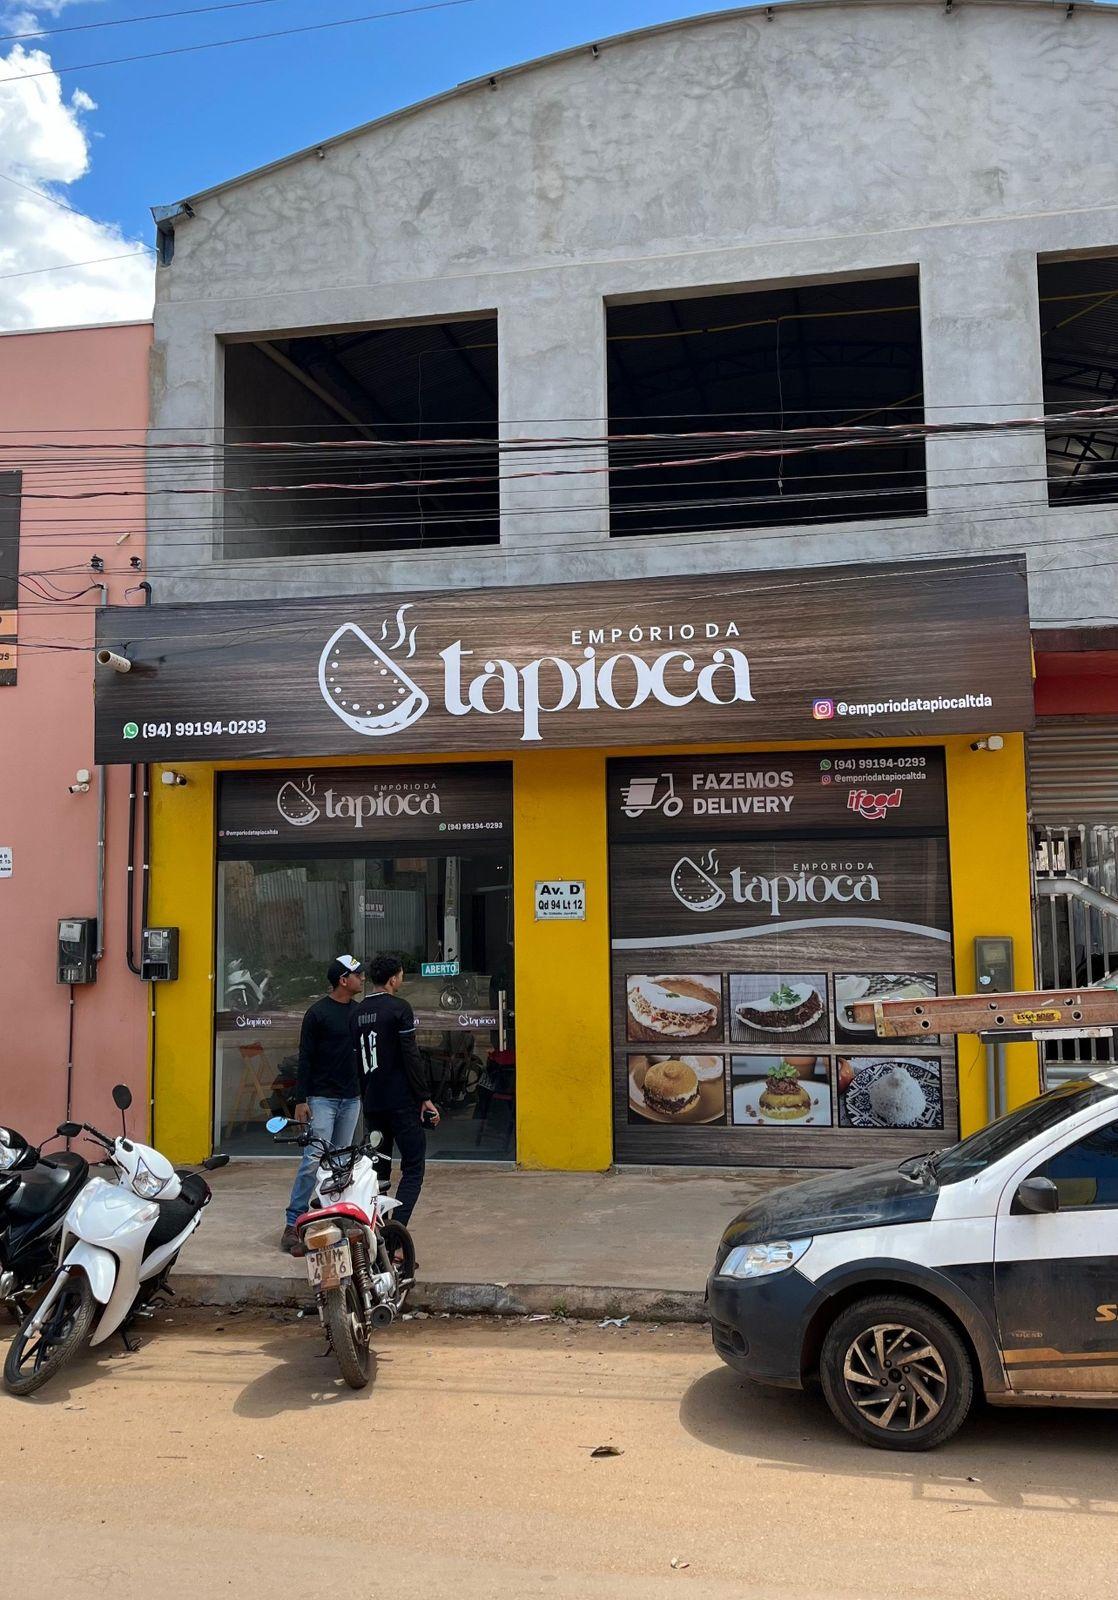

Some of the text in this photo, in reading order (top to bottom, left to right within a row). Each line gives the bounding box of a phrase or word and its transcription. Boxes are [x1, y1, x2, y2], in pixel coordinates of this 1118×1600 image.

[570, 621, 740, 645] EMPÓRIO DA
[438, 640, 757, 742] tapioca
[836, 694, 993, 717] @emporiodatapiocaltda
[141, 719, 267, 739] (94) 99194-0293
[834, 757, 926, 771] (94) 99194-0293
[374, 782, 437, 792] EMPÓRIO DA
[692, 771, 794, 791] FAZEMOS
[834, 771, 926, 784] @emporiodatapiocaltda
[324, 788, 442, 828] tapioca
[693, 795, 795, 815] DELIVERY
[793, 861, 874, 871] EMPÓRIO DA
[540, 884, 581, 896] Av. D
[729, 866, 881, 917] tapioca
[538, 899, 583, 910] Qd 94 Lt 12
[425, 963, 457, 975] ABERTO
[1095, 1304, 1118, 1322] S
